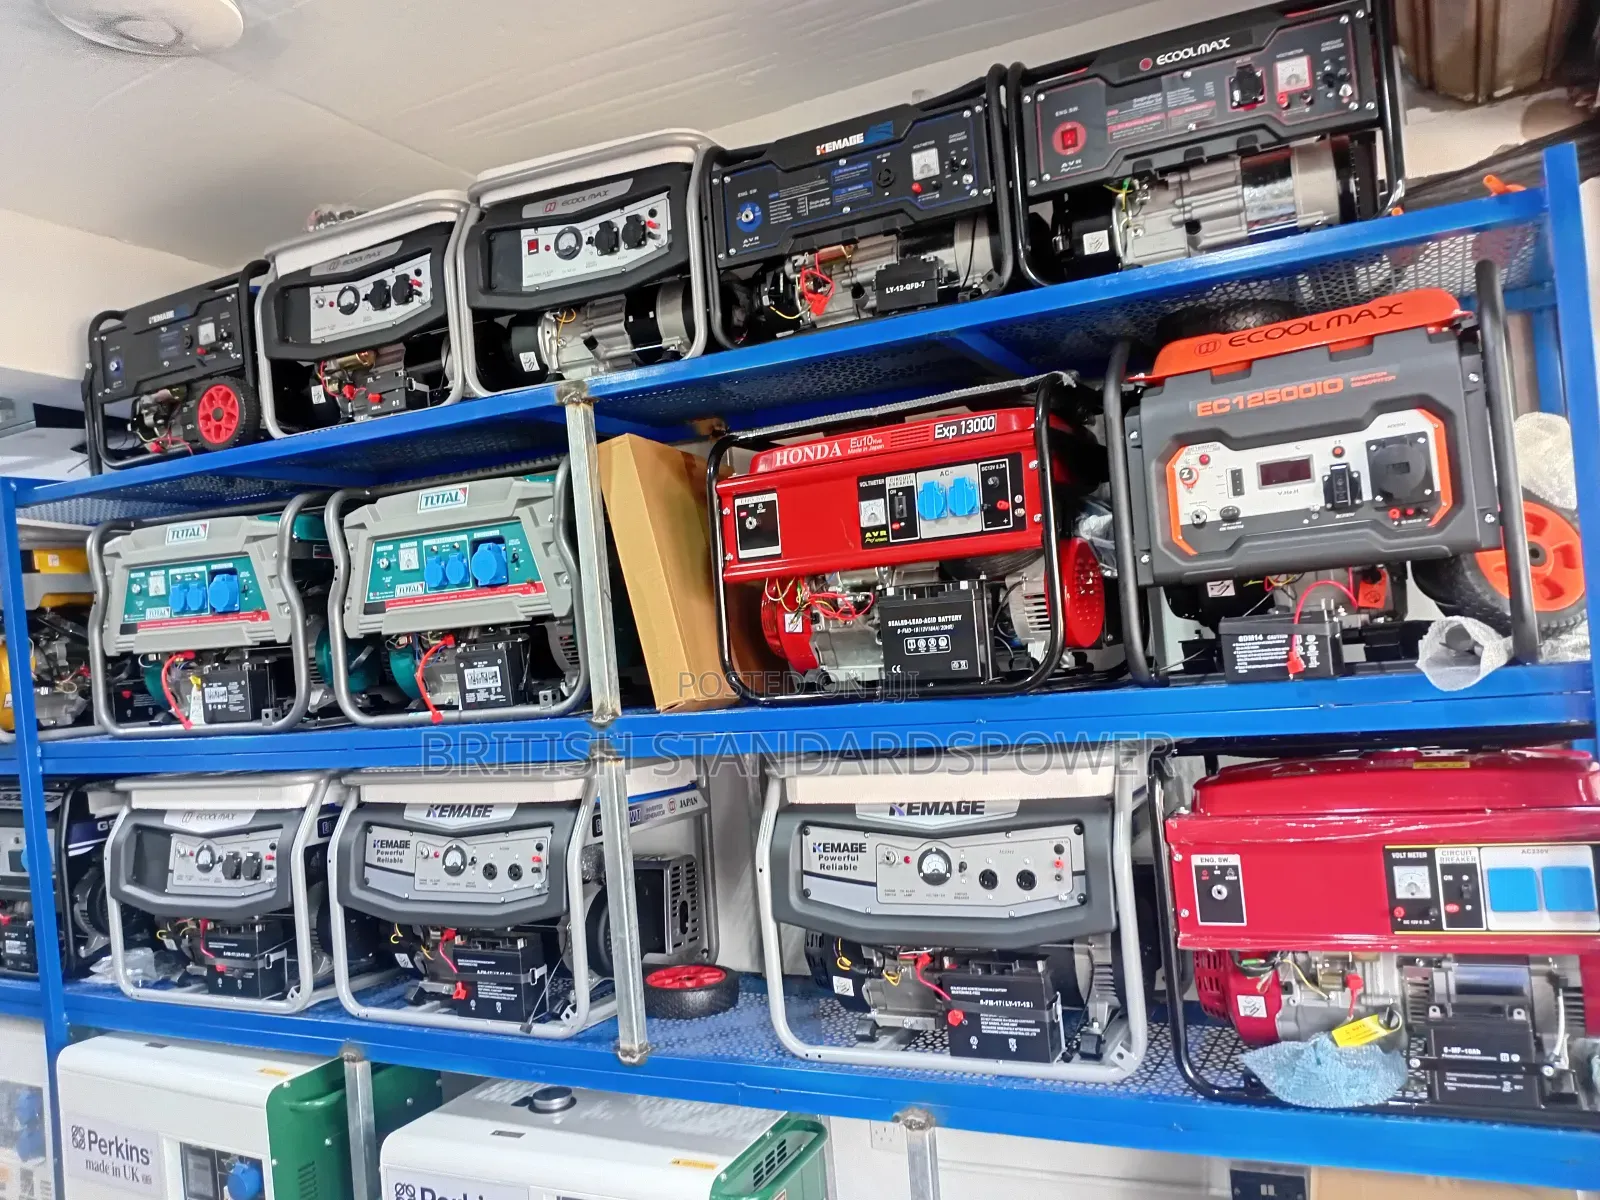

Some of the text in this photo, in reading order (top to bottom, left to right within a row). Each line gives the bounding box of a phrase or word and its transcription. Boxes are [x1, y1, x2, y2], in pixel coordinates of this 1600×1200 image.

[1156, 37, 1230, 65] ECOOLMAX
[816, 132, 864, 156] KEMAGE
[1228, 302, 1403, 348] ECOOLMAX
[935, 415, 995, 439] Exp 13000
[774, 441, 843, 467] HONDA
[859, 478, 885, 488] VOLTMETER
[422, 490, 461, 507] TOTAL
[938, 614, 963, 622] BATTERY
[679, 796, 699, 809] JAPAN
[889, 801, 985, 816] KEMAGE
[425, 804, 494, 818] KEMAGE
[373, 839, 411, 849] KEMAGE
[812, 842, 867, 853] KEMAGE
[376, 856, 404, 864] Reliable
[818, 854, 860, 862] Powerful
[1407, 851, 1428, 859] METER
[819, 862, 858, 872] Reliable
[87, 1130, 151, 1166] Perkins
[85, 1158, 140, 1183] made in UK
